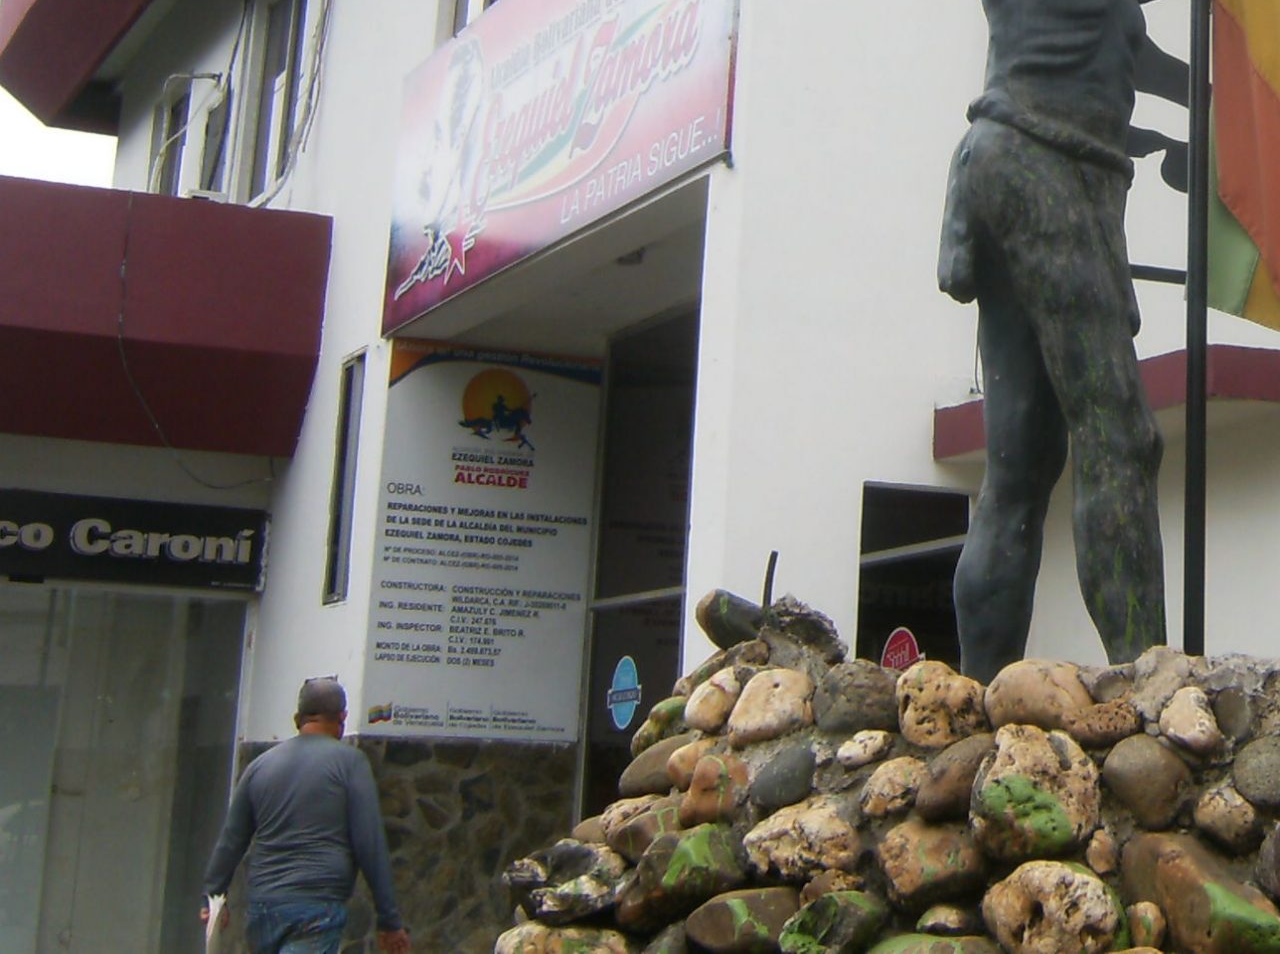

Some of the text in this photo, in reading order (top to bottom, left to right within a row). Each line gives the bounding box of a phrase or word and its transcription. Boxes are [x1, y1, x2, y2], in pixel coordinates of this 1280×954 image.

[560, 188, 581, 224] LA
[583, 153, 643, 212] PATRIA
[452, 452, 534, 467] EZEQUIEL ZAMORA
[454, 472, 528, 489] ALCALDE
[387, 482, 425, 495] OBRA:
[387, 502, 449, 515] REPARACIONES
[457, 507, 495, 518] MEJORAS
[496, 511, 508, 519] EN
[510, 512, 525, 520] LAS
[526, 513, 588, 526] INSTALACIONES
[386, 515, 397, 523] DE
[399, 516, 409, 524] LA
[411, 517, 432, 526] SEDE
[434, 519, 445, 527] DE
[446, 520, 457, 528] LA
[499, 524, 514, 533] DEL
[515, 525, 558, 536] MUNICIPIO
[70, 518, 254, 564] Caroní
[385, 528, 533, 547] EZEQUIEL ZAMORA, ESTADO COJEDES
[522, 589, 581, 601] REPARACIONES
[449, 625, 482, 635] BEATRIZ
[493, 627, 517, 637] BRITO
[376, 641, 400, 650] MONTO
[375, 653, 395, 662] LAPSO
[446, 656, 461, 665] DOS
[472, 658, 494, 667] MESES
[393, 712, 439, 720] Bolivariano
